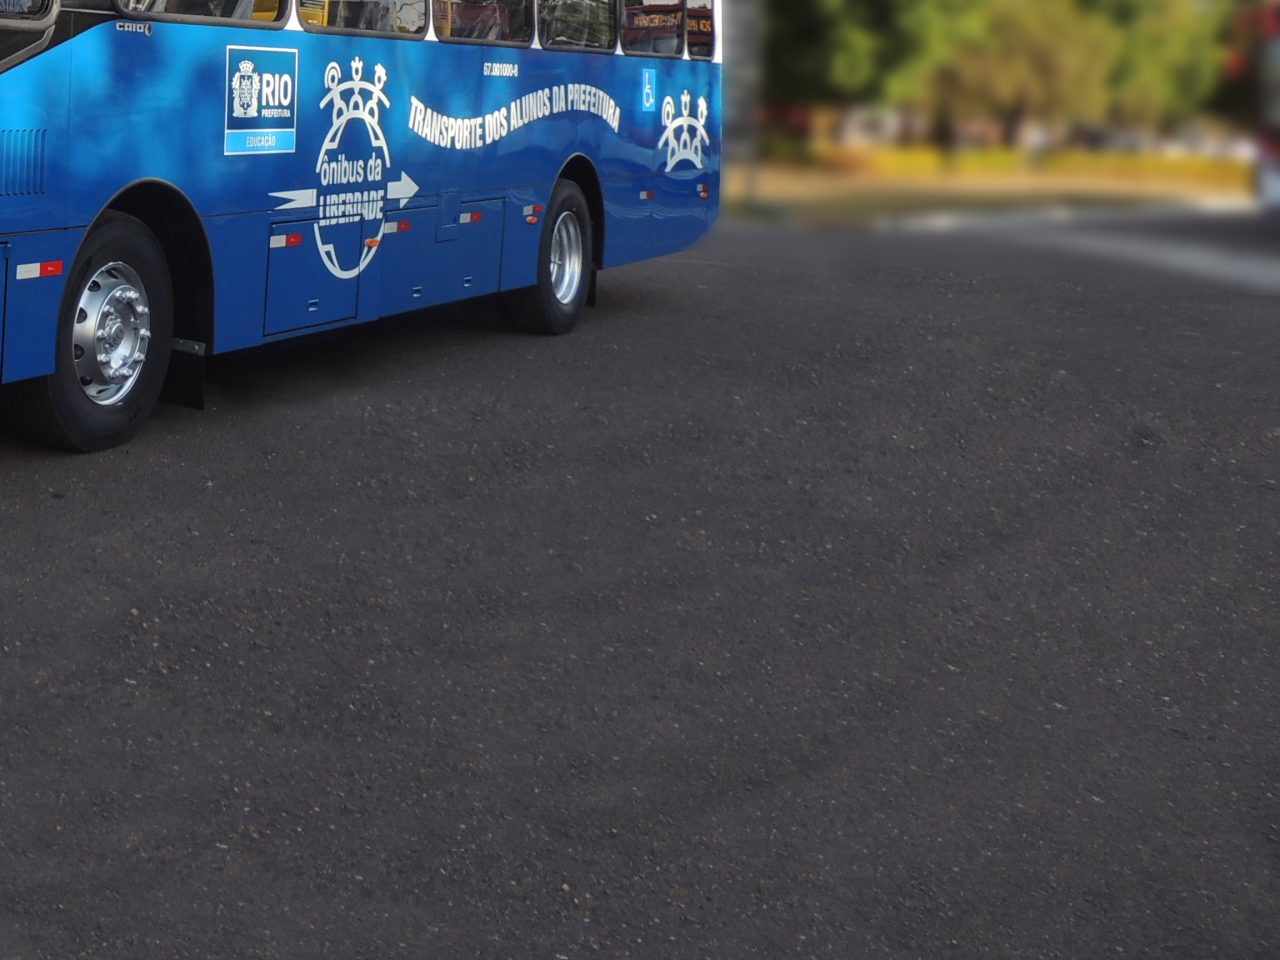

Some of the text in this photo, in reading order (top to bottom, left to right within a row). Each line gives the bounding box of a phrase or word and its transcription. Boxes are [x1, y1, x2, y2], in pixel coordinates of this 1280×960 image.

[483, 62, 519, 77] 67.001000-8
[261, 73, 292, 106] RIO
[261, 108, 291, 118] PREFEITURA
[408, 83, 621, 150] TRANSPORTE DOS ALUNOS DA PREFEITURA
[245, 133, 277, 150] EDUCAÇÃO
[320, 151, 383, 186] ônibus da
[318, 189, 385, 227] LIBERDADE
